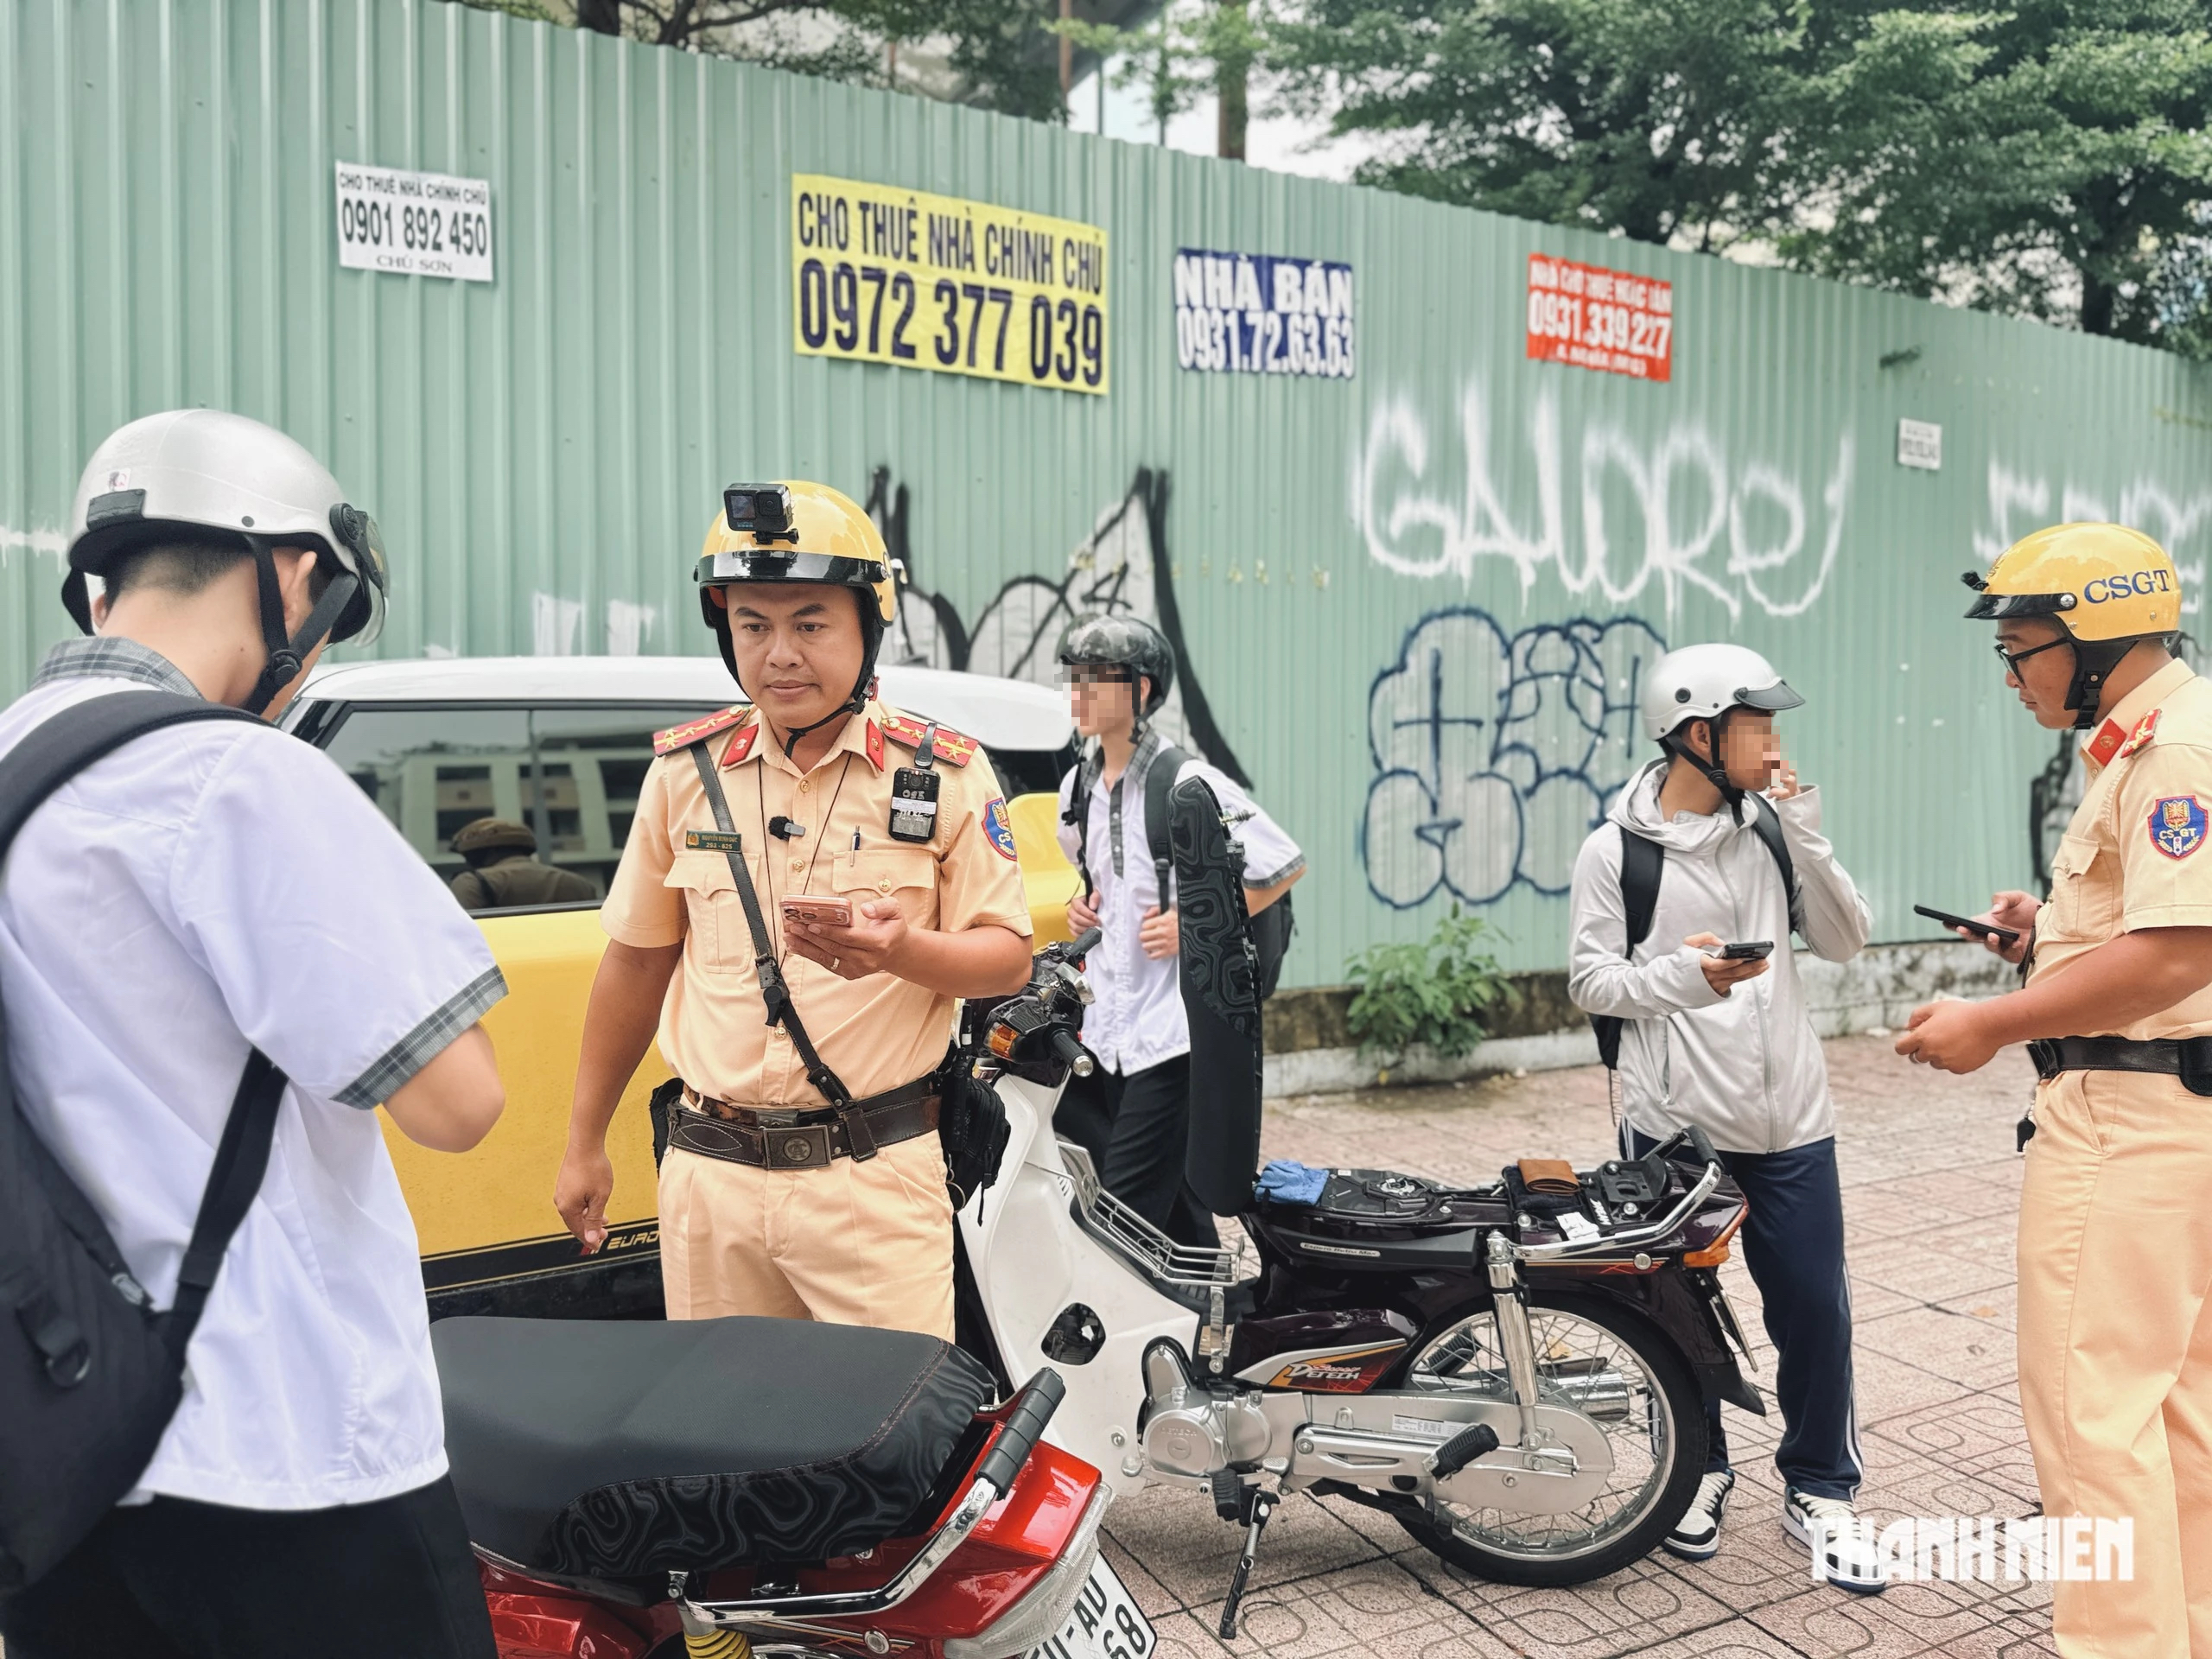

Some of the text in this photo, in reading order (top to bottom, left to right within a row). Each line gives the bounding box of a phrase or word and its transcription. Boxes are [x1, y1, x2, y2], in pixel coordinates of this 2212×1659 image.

[339, 172, 362, 191] CHO
[365, 175, 396, 194] THUÊ
[399, 176, 423, 197] NHÀ
[426, 180, 461, 203] CHÍNH
[342, 198, 487, 257] 0901 892 450
[799, 192, 1103, 296] CHO THUÊ NHÀ CHÍNH CHỦ
[1173, 252, 1353, 318] NHÀ BÁN
[800, 257, 1103, 387] 0972 377 039
[1176, 307, 1355, 378] 0931.72.63.63
[2083, 569, 2170, 604] CSGT
[998, 831, 1012, 844] CS
[2159, 827, 2197, 840] CS GT
[607, 1230, 660, 1250] EURO
